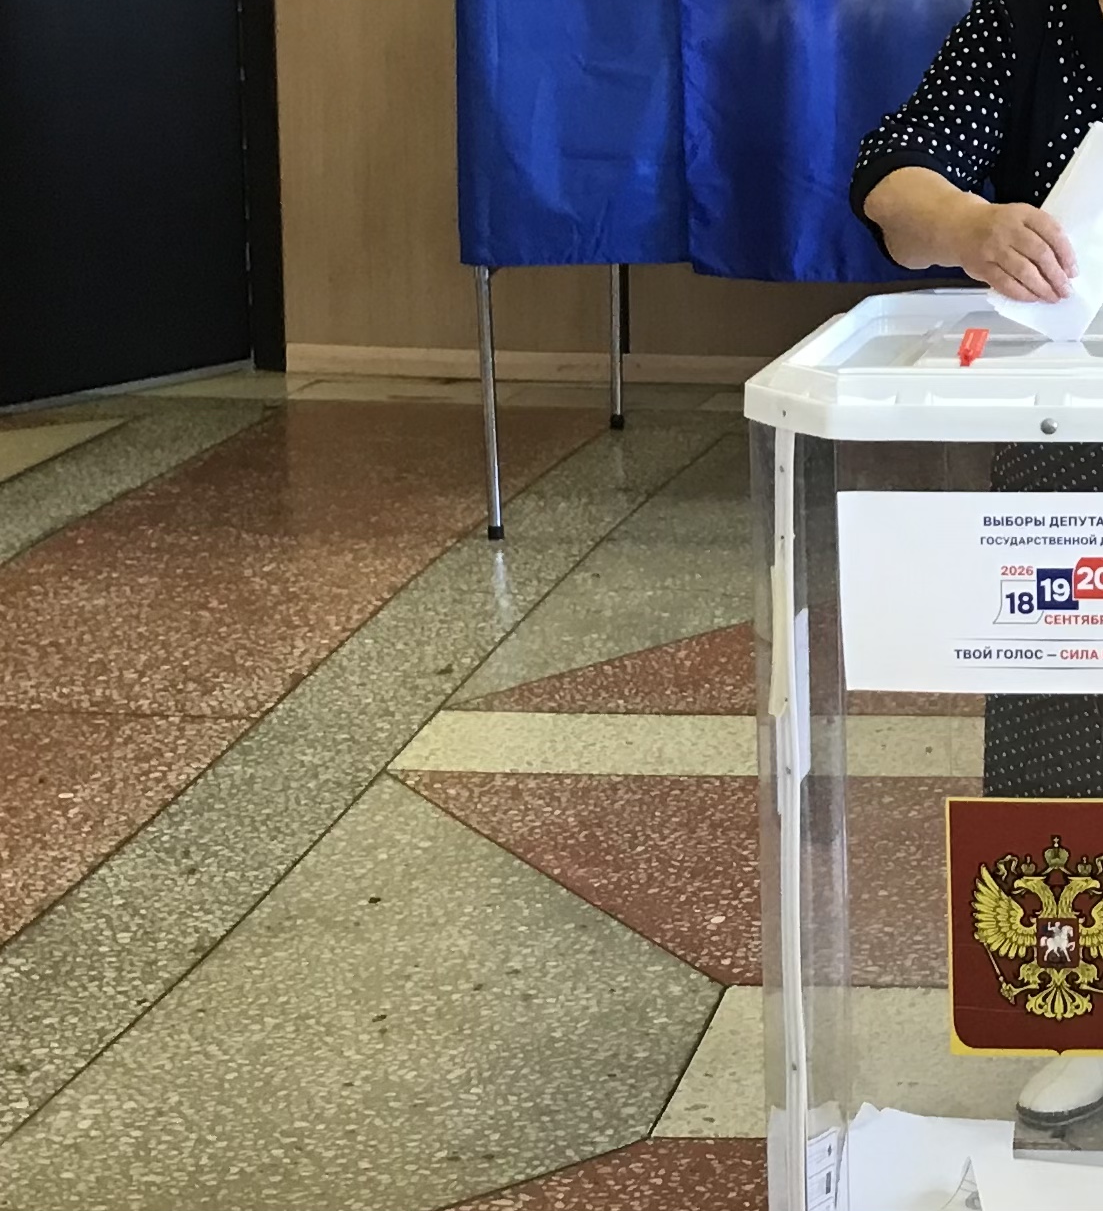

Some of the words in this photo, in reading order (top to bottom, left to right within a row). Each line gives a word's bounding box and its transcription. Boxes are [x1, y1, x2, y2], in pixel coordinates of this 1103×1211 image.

[983, 516, 1045, 527] ВЫБОРЫ
[980, 535, 1097, 546] ГОСУДАРСТВЕННОЙ
[1001, 565, 1034, 576] 2026
[1005, 592, 1035, 615] 18
[1040, 578, 1070, 602] 19
[954, 646, 992, 660] ТВОЙ
[996, 649, 1043, 660] ГОЛОС
[1060, 649, 1099, 660] СИЛА
